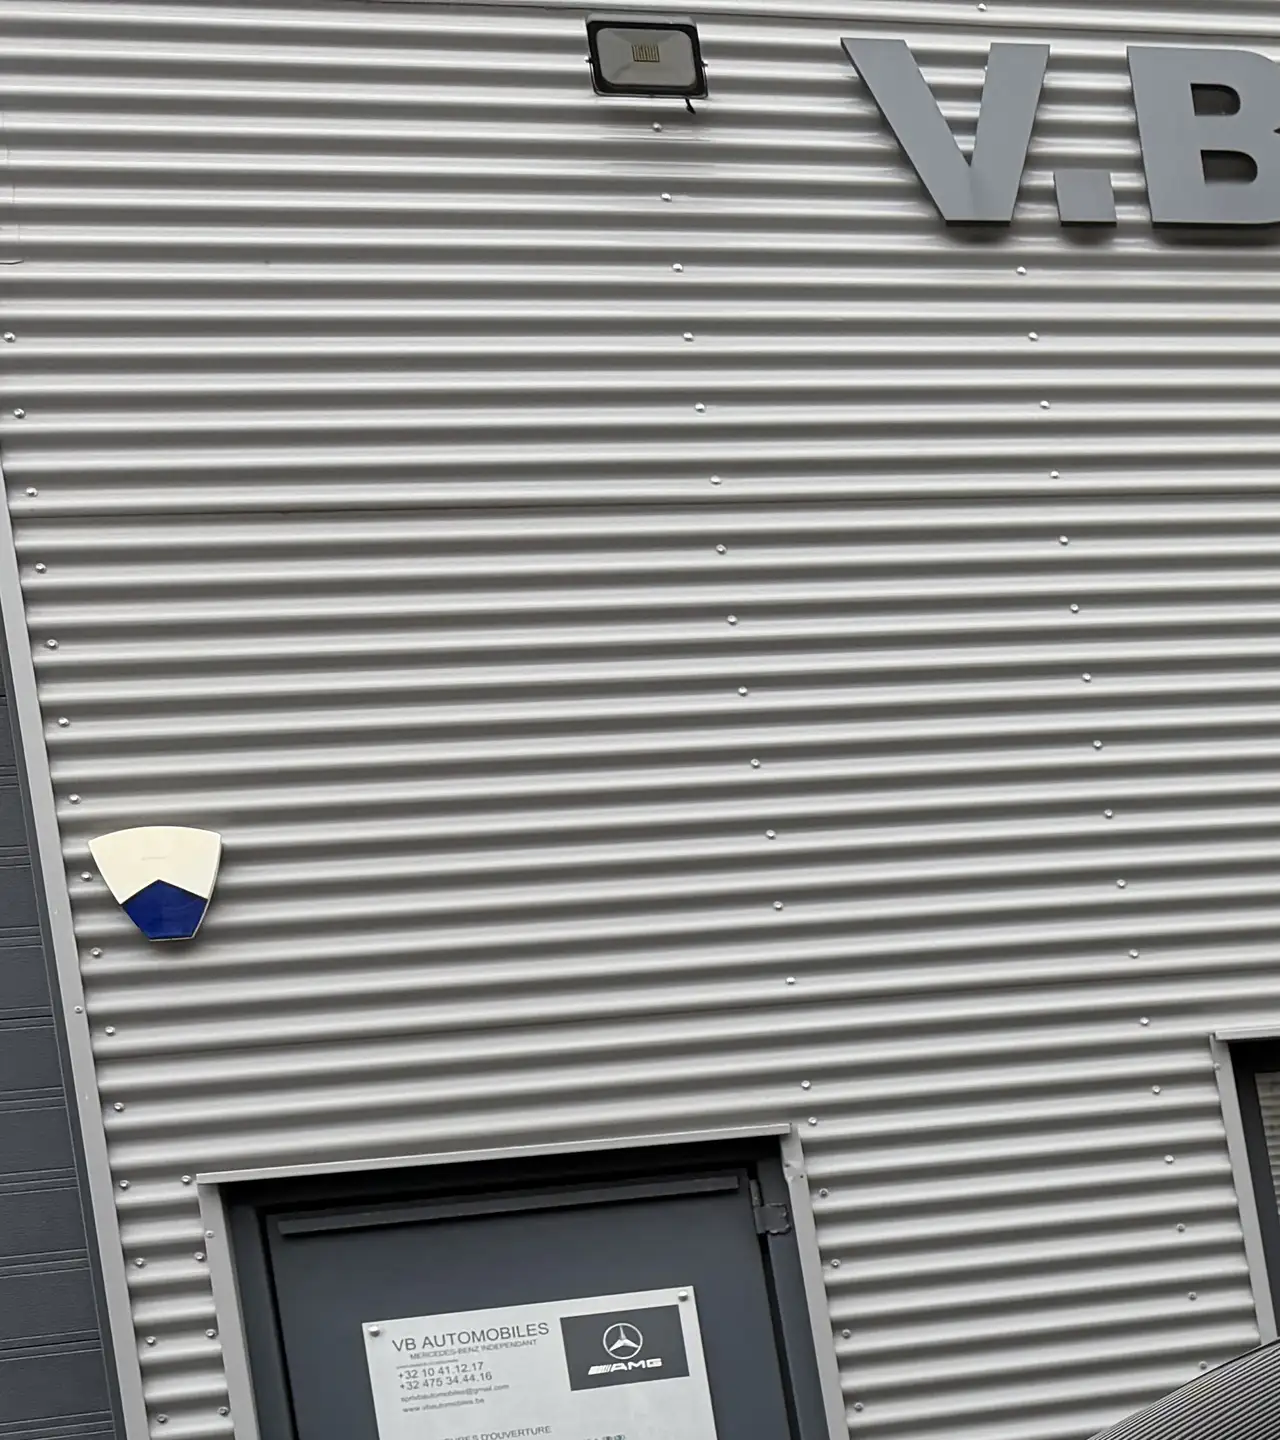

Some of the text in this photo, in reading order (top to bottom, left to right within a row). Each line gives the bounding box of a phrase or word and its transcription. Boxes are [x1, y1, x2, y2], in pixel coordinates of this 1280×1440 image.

[392, 1322, 550, 1352] VB AUTOMOBILES
[399, 1369, 418, 1380] +32
[422, 1367, 435, 1378] 10
[437, 1361, 484, 1375] 41.12.17
[400, 1371, 493, 1391] +32 475 34.44.16
